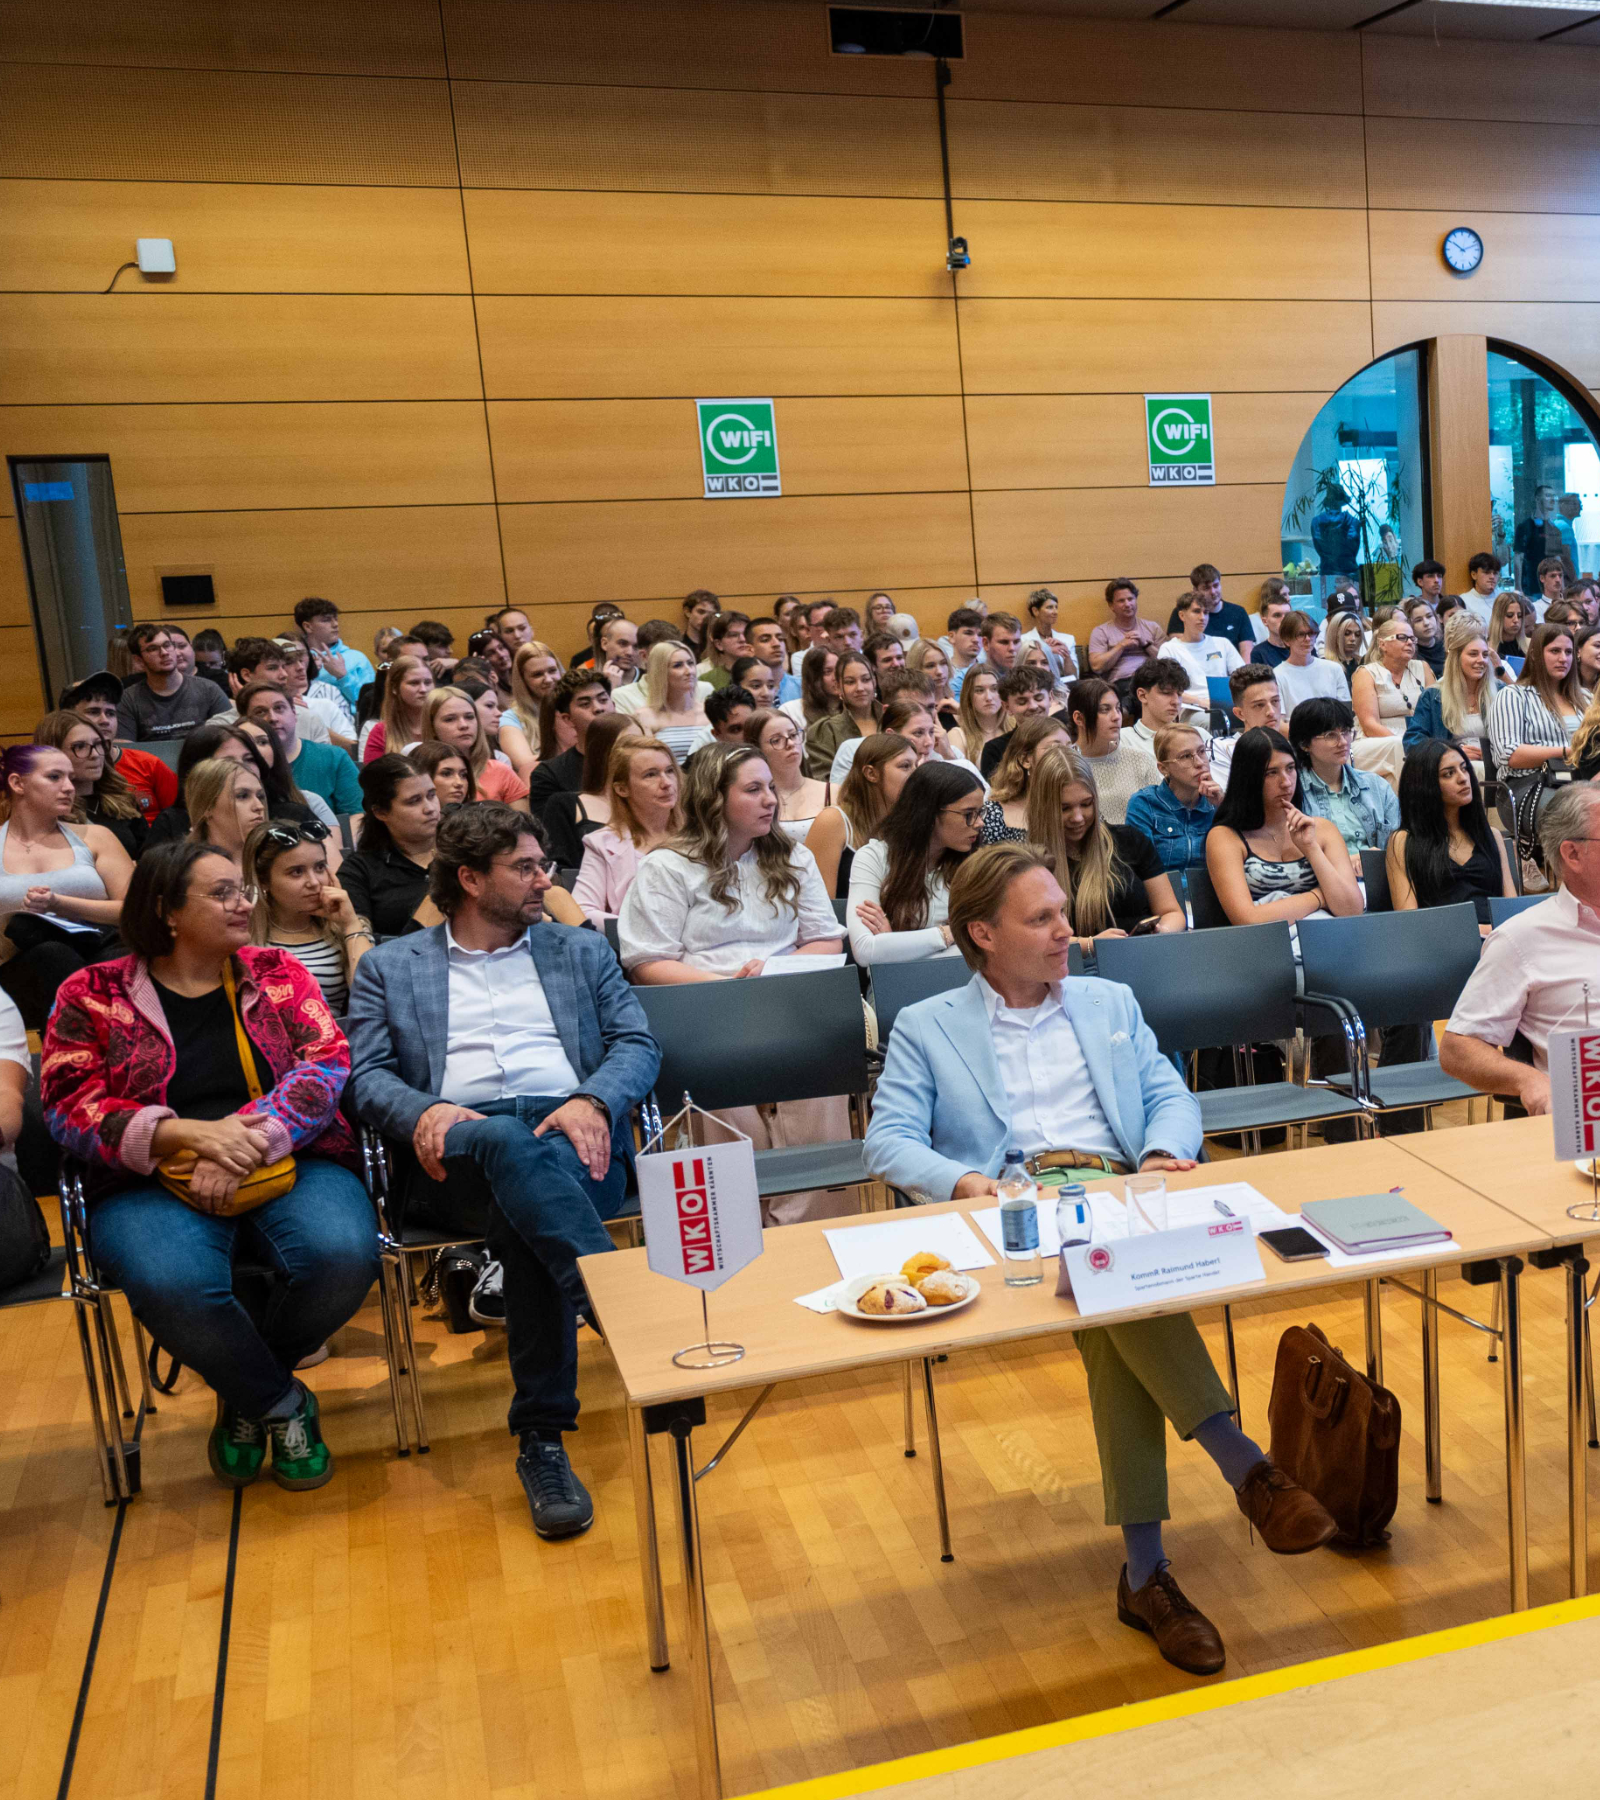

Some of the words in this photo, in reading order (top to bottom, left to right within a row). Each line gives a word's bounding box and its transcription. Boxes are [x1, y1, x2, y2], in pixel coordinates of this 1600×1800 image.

[720, 430, 772, 448] WIFI
[1164, 423, 1208, 440] WIFI
[707, 476, 759, 491] WKO
[1151, 466, 1196, 480] WKO
[1570, 1038, 1580, 1118] WIRTSCHAFTSKAMMER
[707, 1156, 716, 1189] KÄRNTEN
[680, 1193, 711, 1273] WKO
[710, 1191, 724, 1270] WIRTSCHAFTSKAMMER
[1208, 1224, 1233, 1235] WKO
[1131, 1269, 1160, 1281] KommR
[1161, 1262, 1194, 1274] Raimund
[1196, 1256, 1221, 1267] Haberl
